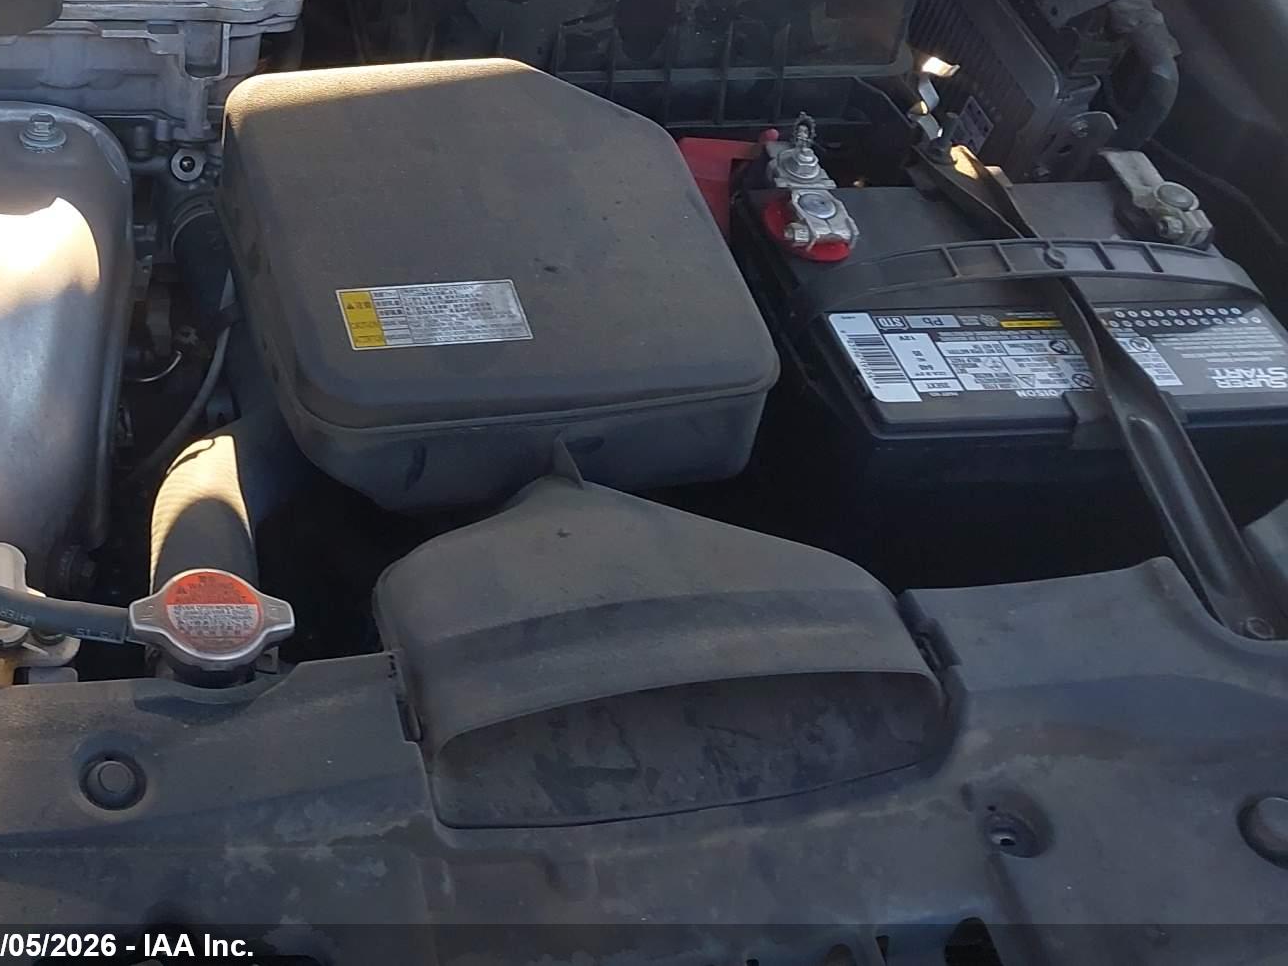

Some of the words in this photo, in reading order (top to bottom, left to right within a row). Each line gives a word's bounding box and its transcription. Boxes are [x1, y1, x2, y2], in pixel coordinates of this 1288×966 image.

[922, 316, 944, 327] Pb
[1212, 366, 1288, 379] START
[1215, 378, 1288, 390] SUPER
[1015, 388, 1062, 400] OISON
